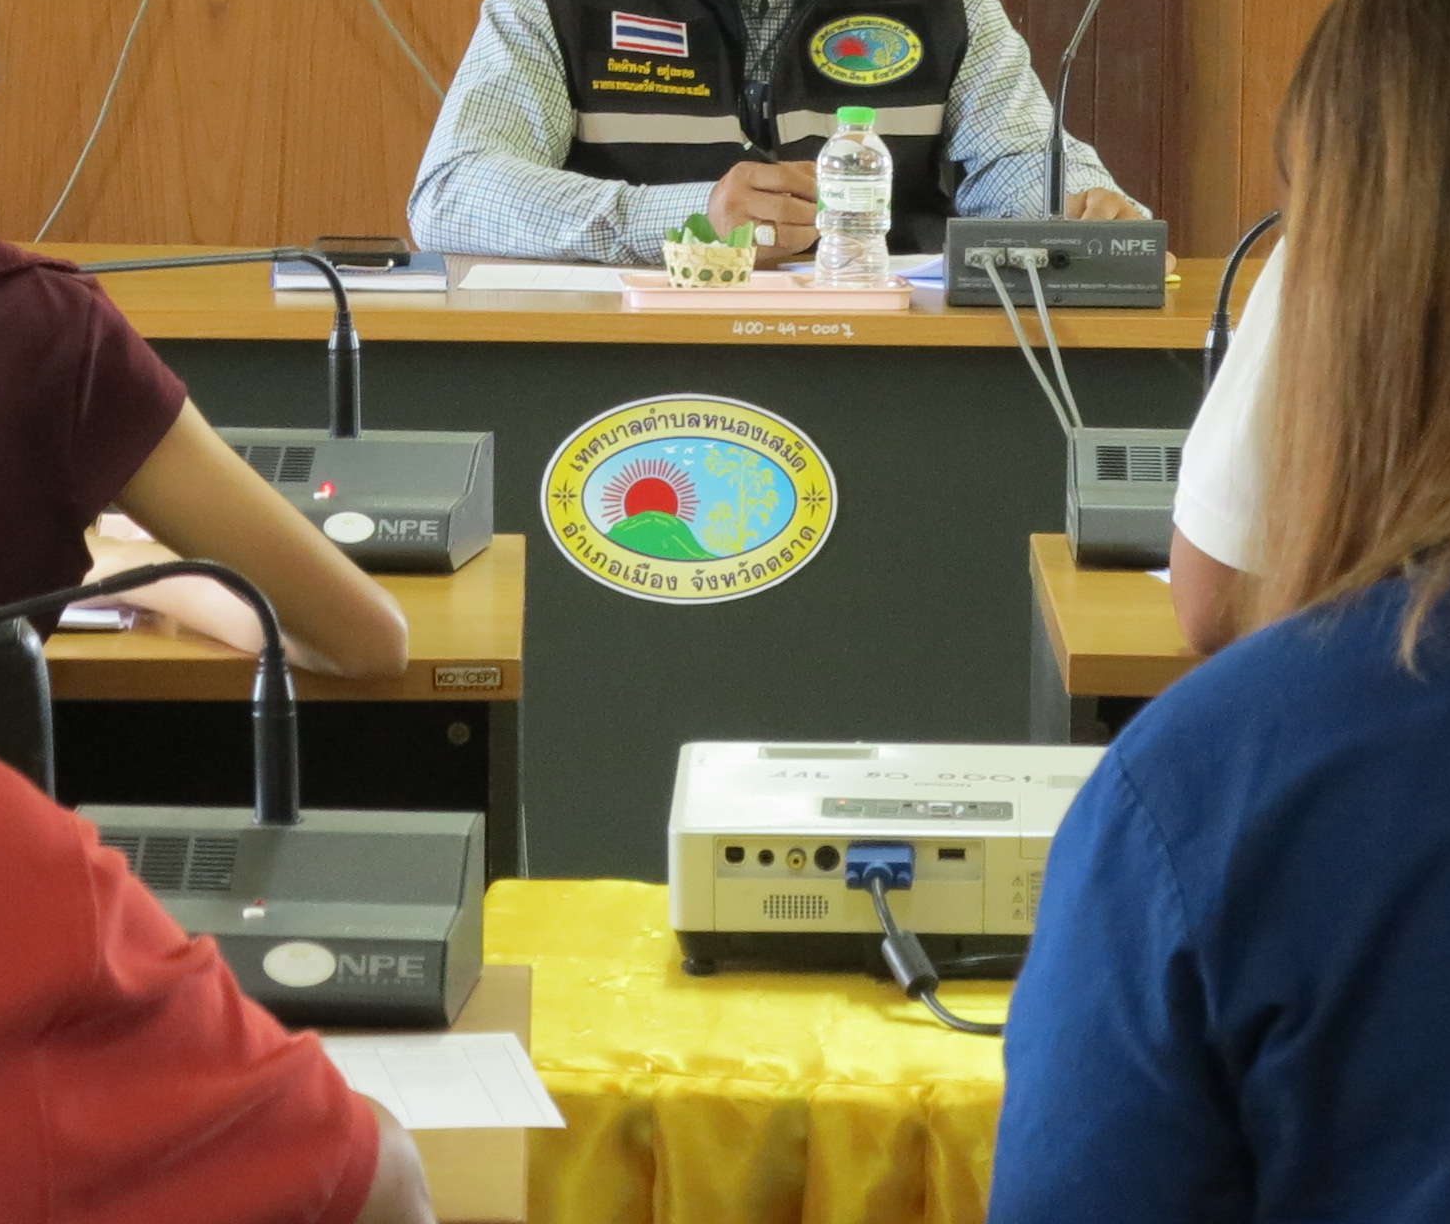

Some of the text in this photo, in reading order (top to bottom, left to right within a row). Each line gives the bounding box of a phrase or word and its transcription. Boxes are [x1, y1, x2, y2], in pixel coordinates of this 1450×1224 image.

[1110, 239, 1157, 252] NPE
[570, 408, 807, 474] เทศบาลตำบลหนองเสม็ด
[377, 518, 439, 536] NPE
[562, 521, 817, 592] อำเภอเมือง จังหวัดตราด
[336, 955, 425, 978] NPE
